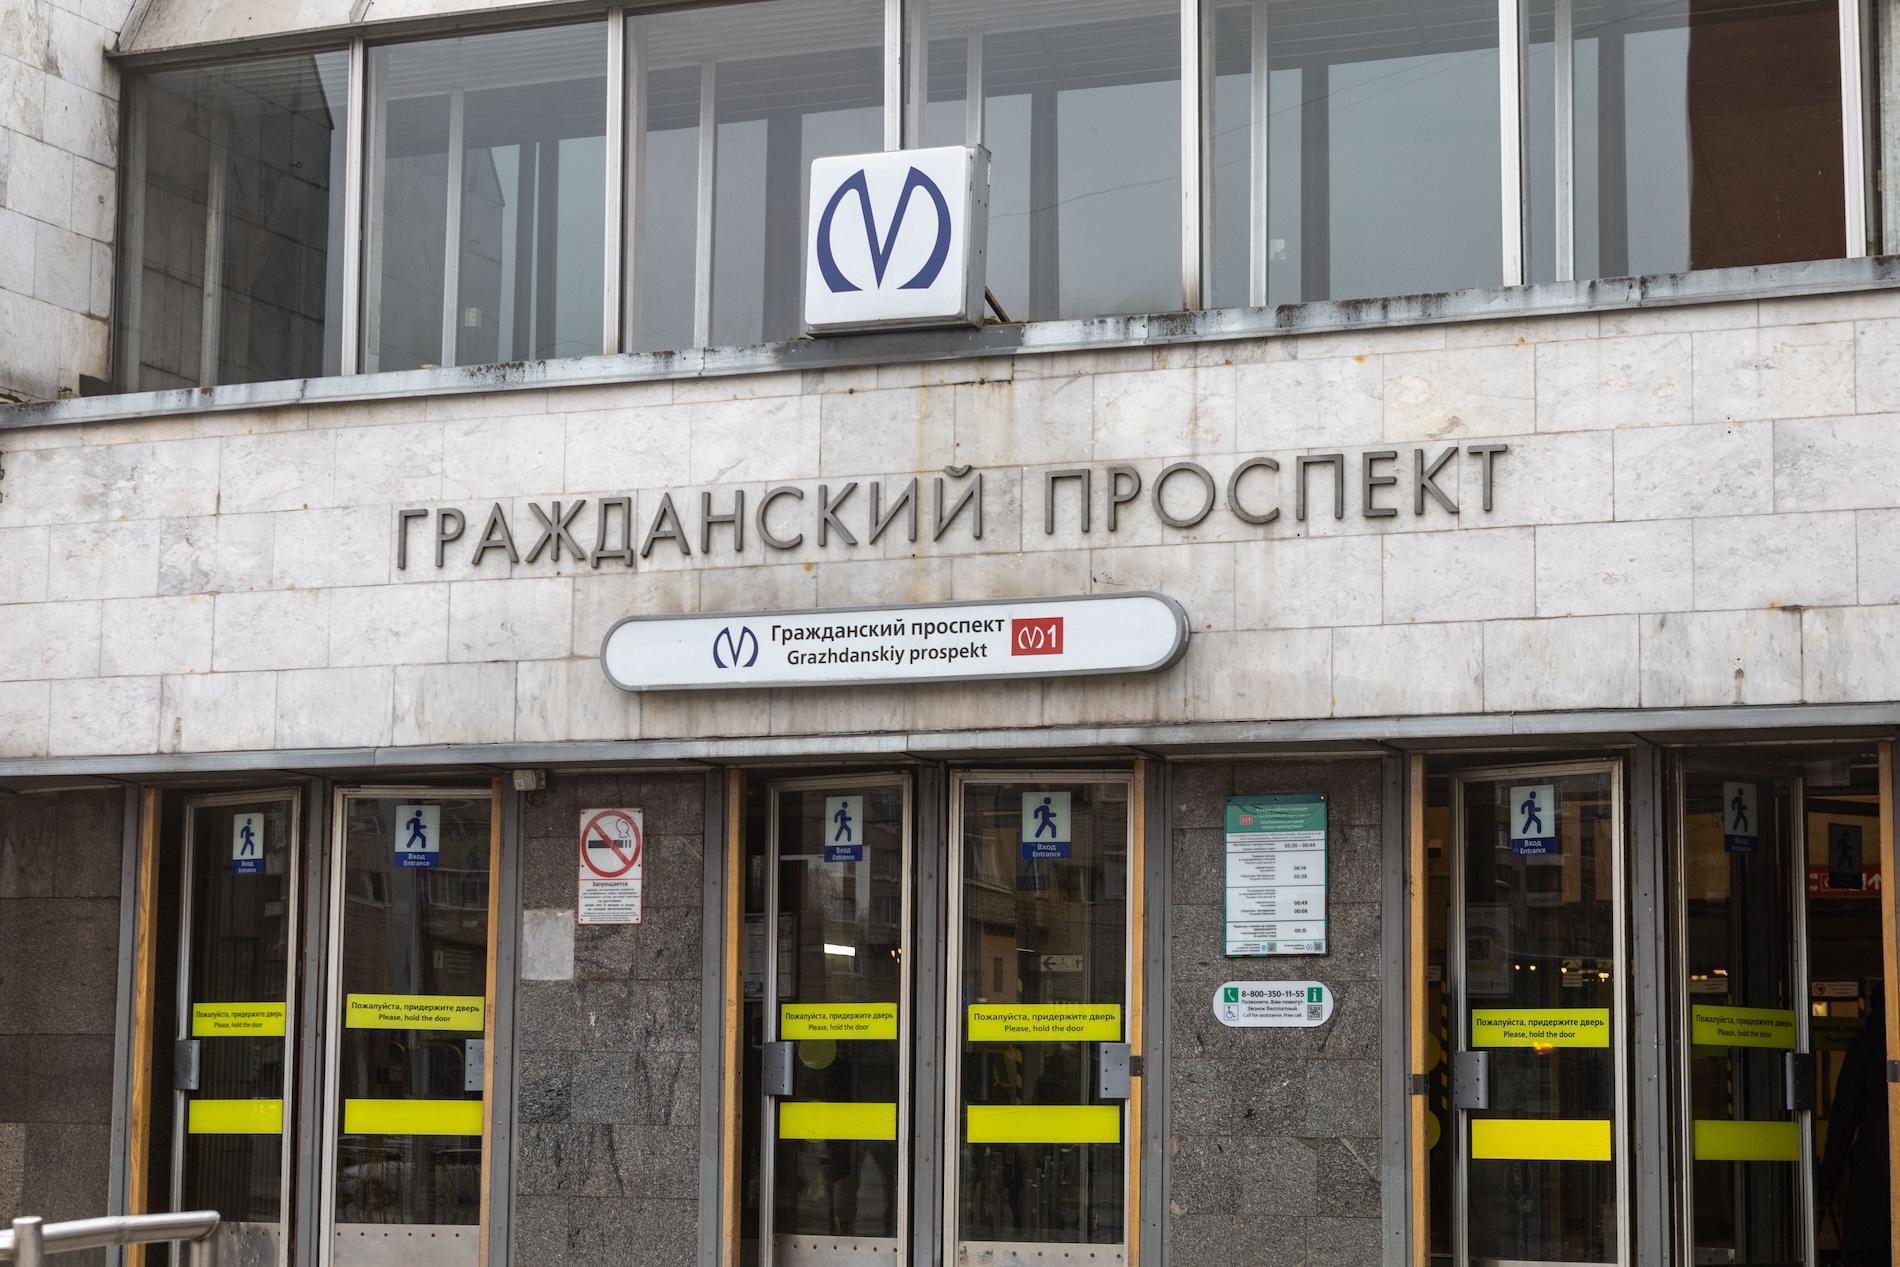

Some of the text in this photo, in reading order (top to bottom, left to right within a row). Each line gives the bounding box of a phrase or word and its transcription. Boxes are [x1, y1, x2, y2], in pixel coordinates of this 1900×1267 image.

[397, 443, 1508, 570] ГРАЖДАНСКИЙ ПРОСПЕКТ
[771, 618, 1005, 646] Гражданский проспект
[787, 642, 988, 665] Grazhdanskiy prospekt
[1037, 843, 1057, 851] Вход
[1524, 839, 1542, 847] Вход
[836, 846, 851, 854] Вход
[1519, 847, 1547, 855] Entrance
[1241, 990, 1305, 998] 8-800-350-11-55
[351, 1002, 480, 1013] Пожалуйста, придержите дверь
[378, 1013, 402, 1021] Please,
[785, 1012, 828, 1021] Пожалуйста,
[974, 1012, 1116, 1022] Пожалуйста, придержите дверь
[1476, 1018, 1605, 1028] Пожалуйста, придержите дверь
[1503, 1031, 1528, 1039] Please,
[1529, 1030, 1545, 1038] hold
[1546, 1030, 1558, 1038] the
